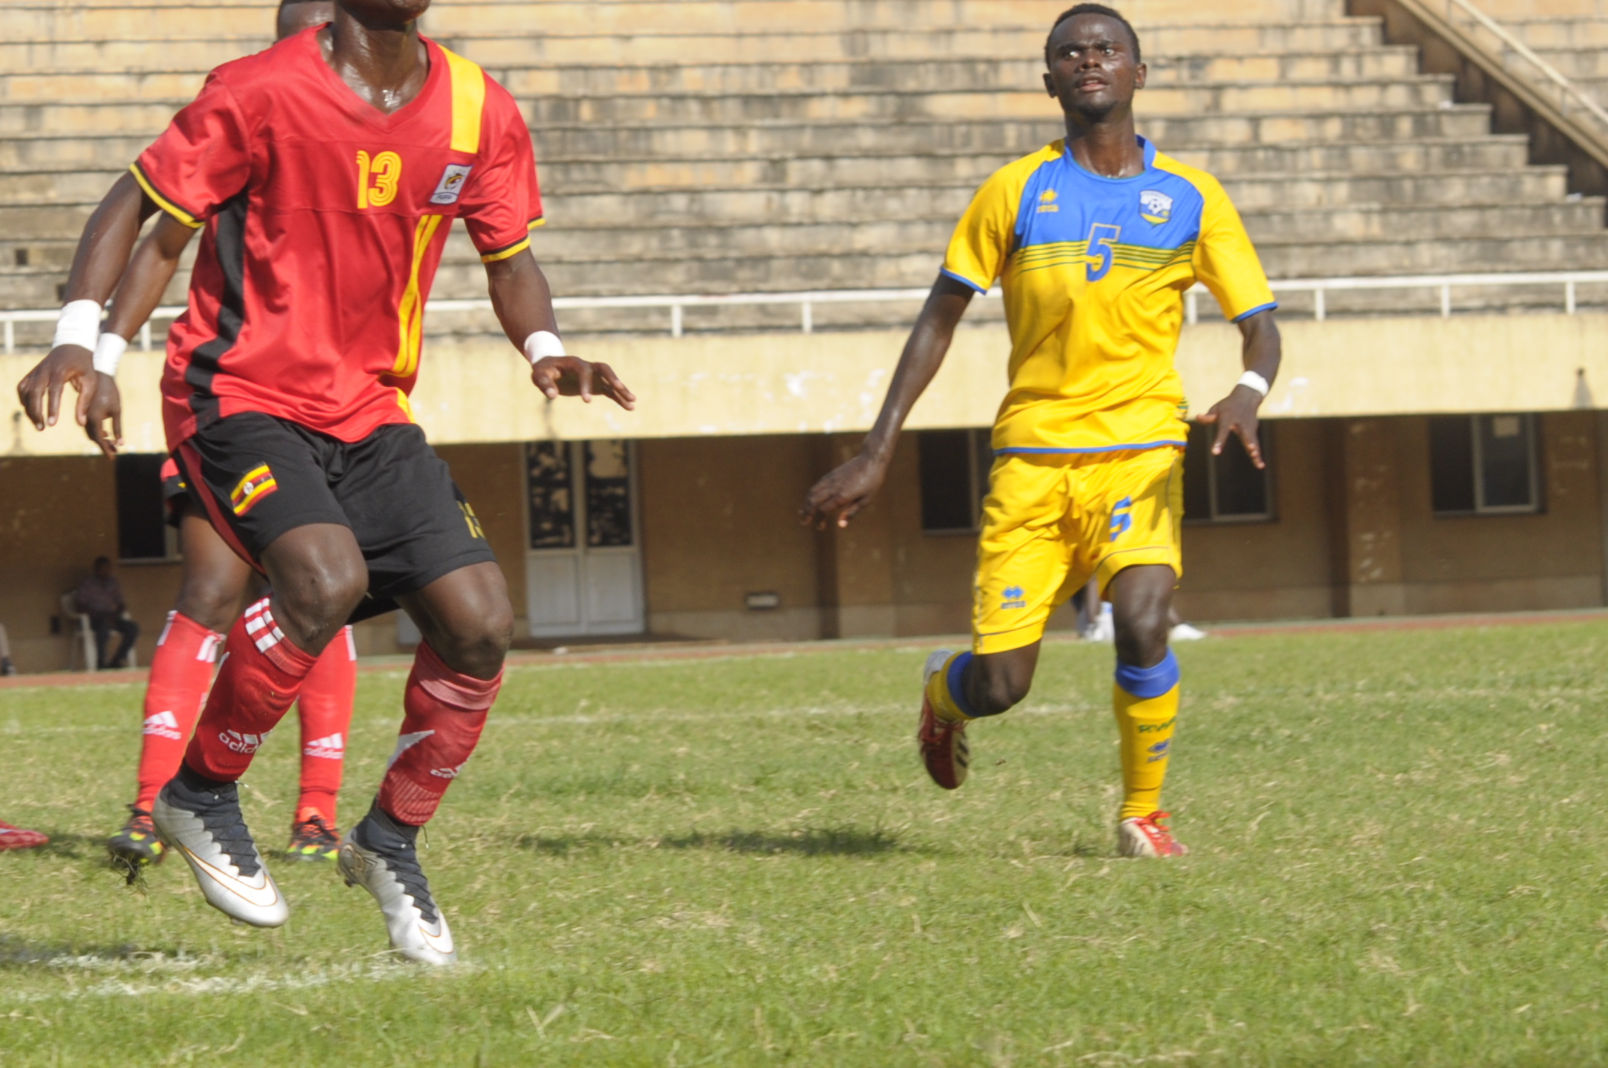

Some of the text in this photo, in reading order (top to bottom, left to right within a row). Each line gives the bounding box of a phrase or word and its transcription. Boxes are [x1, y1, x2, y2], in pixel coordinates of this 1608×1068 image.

[356, 149, 402, 209] 13
[1085, 222, 1122, 282] 5
[1109, 495, 1132, 542] 5
[218, 732, 259, 754] adid
